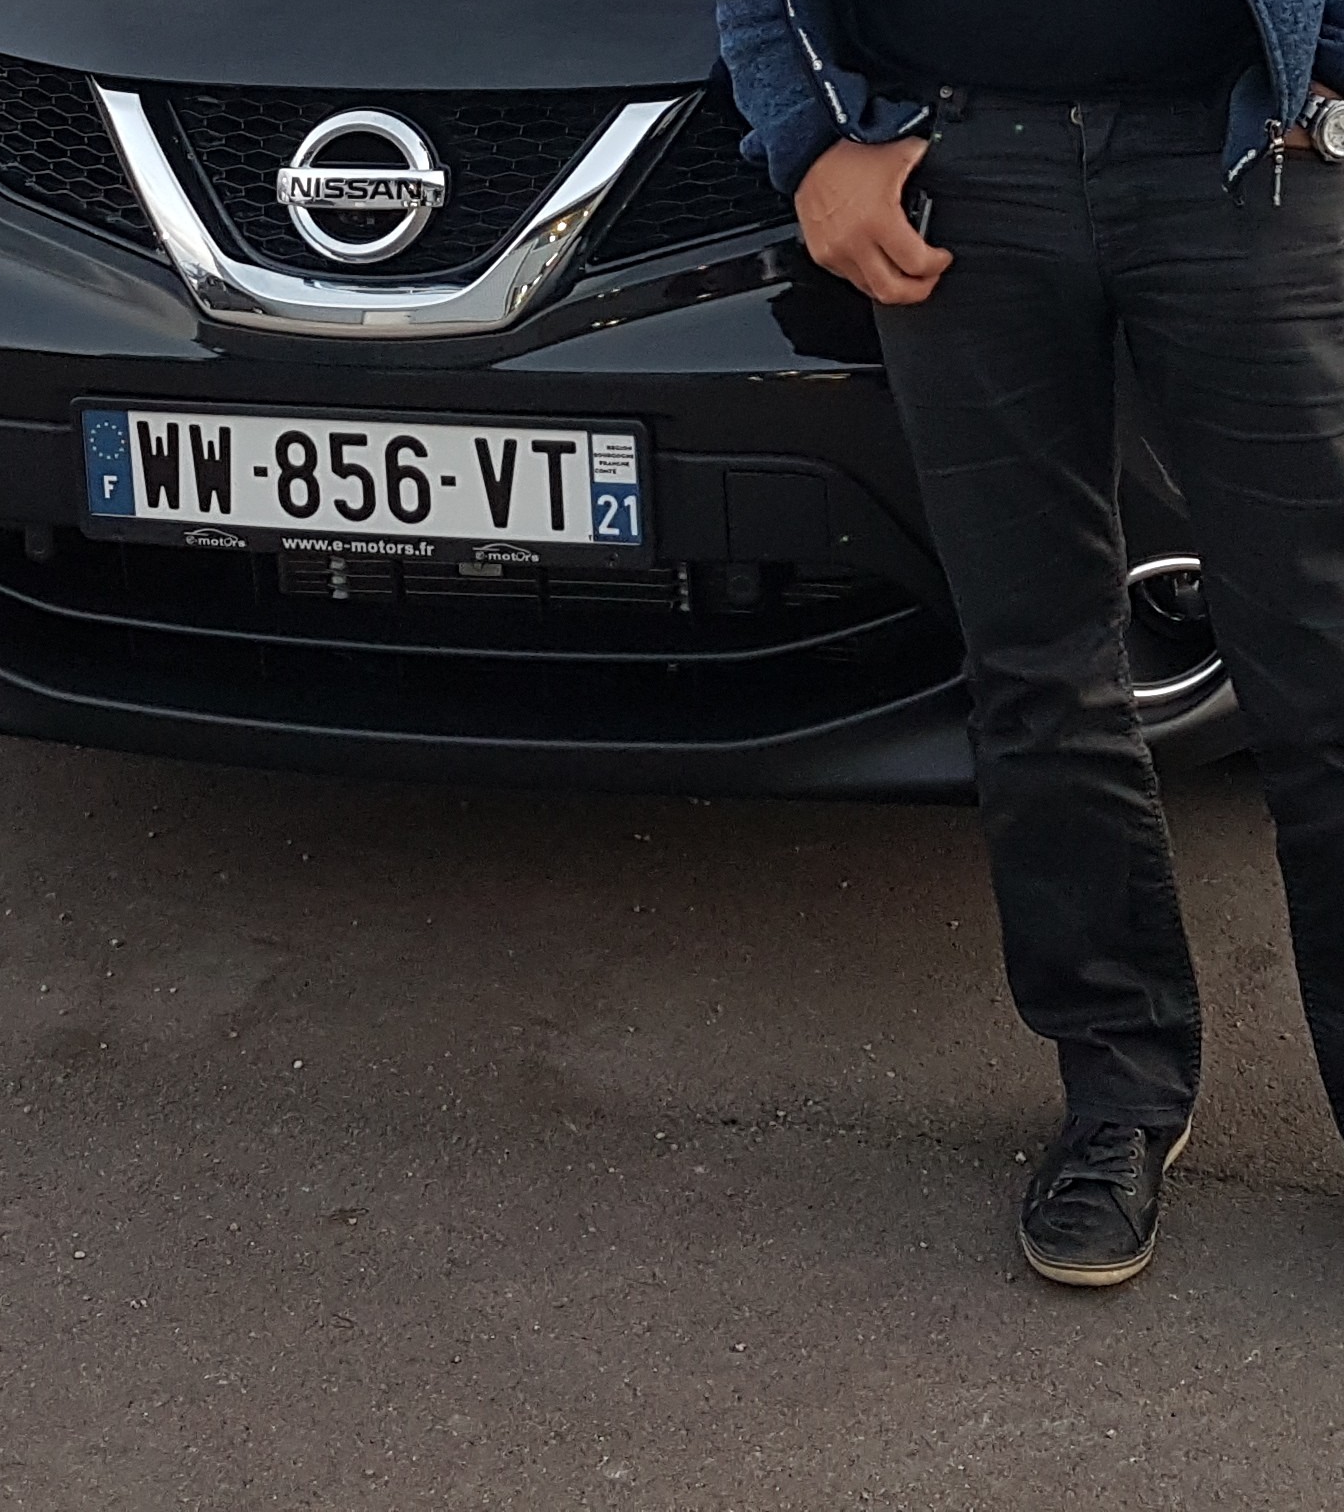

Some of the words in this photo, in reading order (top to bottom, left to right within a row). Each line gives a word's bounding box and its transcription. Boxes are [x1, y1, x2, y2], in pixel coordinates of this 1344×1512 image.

[290, 176, 423, 201] NISSAN
[103, 475, 117, 500] F
[136, 420, 576, 532] WW-856-VT
[597, 494, 638, 536] 21
[282, 536, 435, 557] www.e-motors.fr
